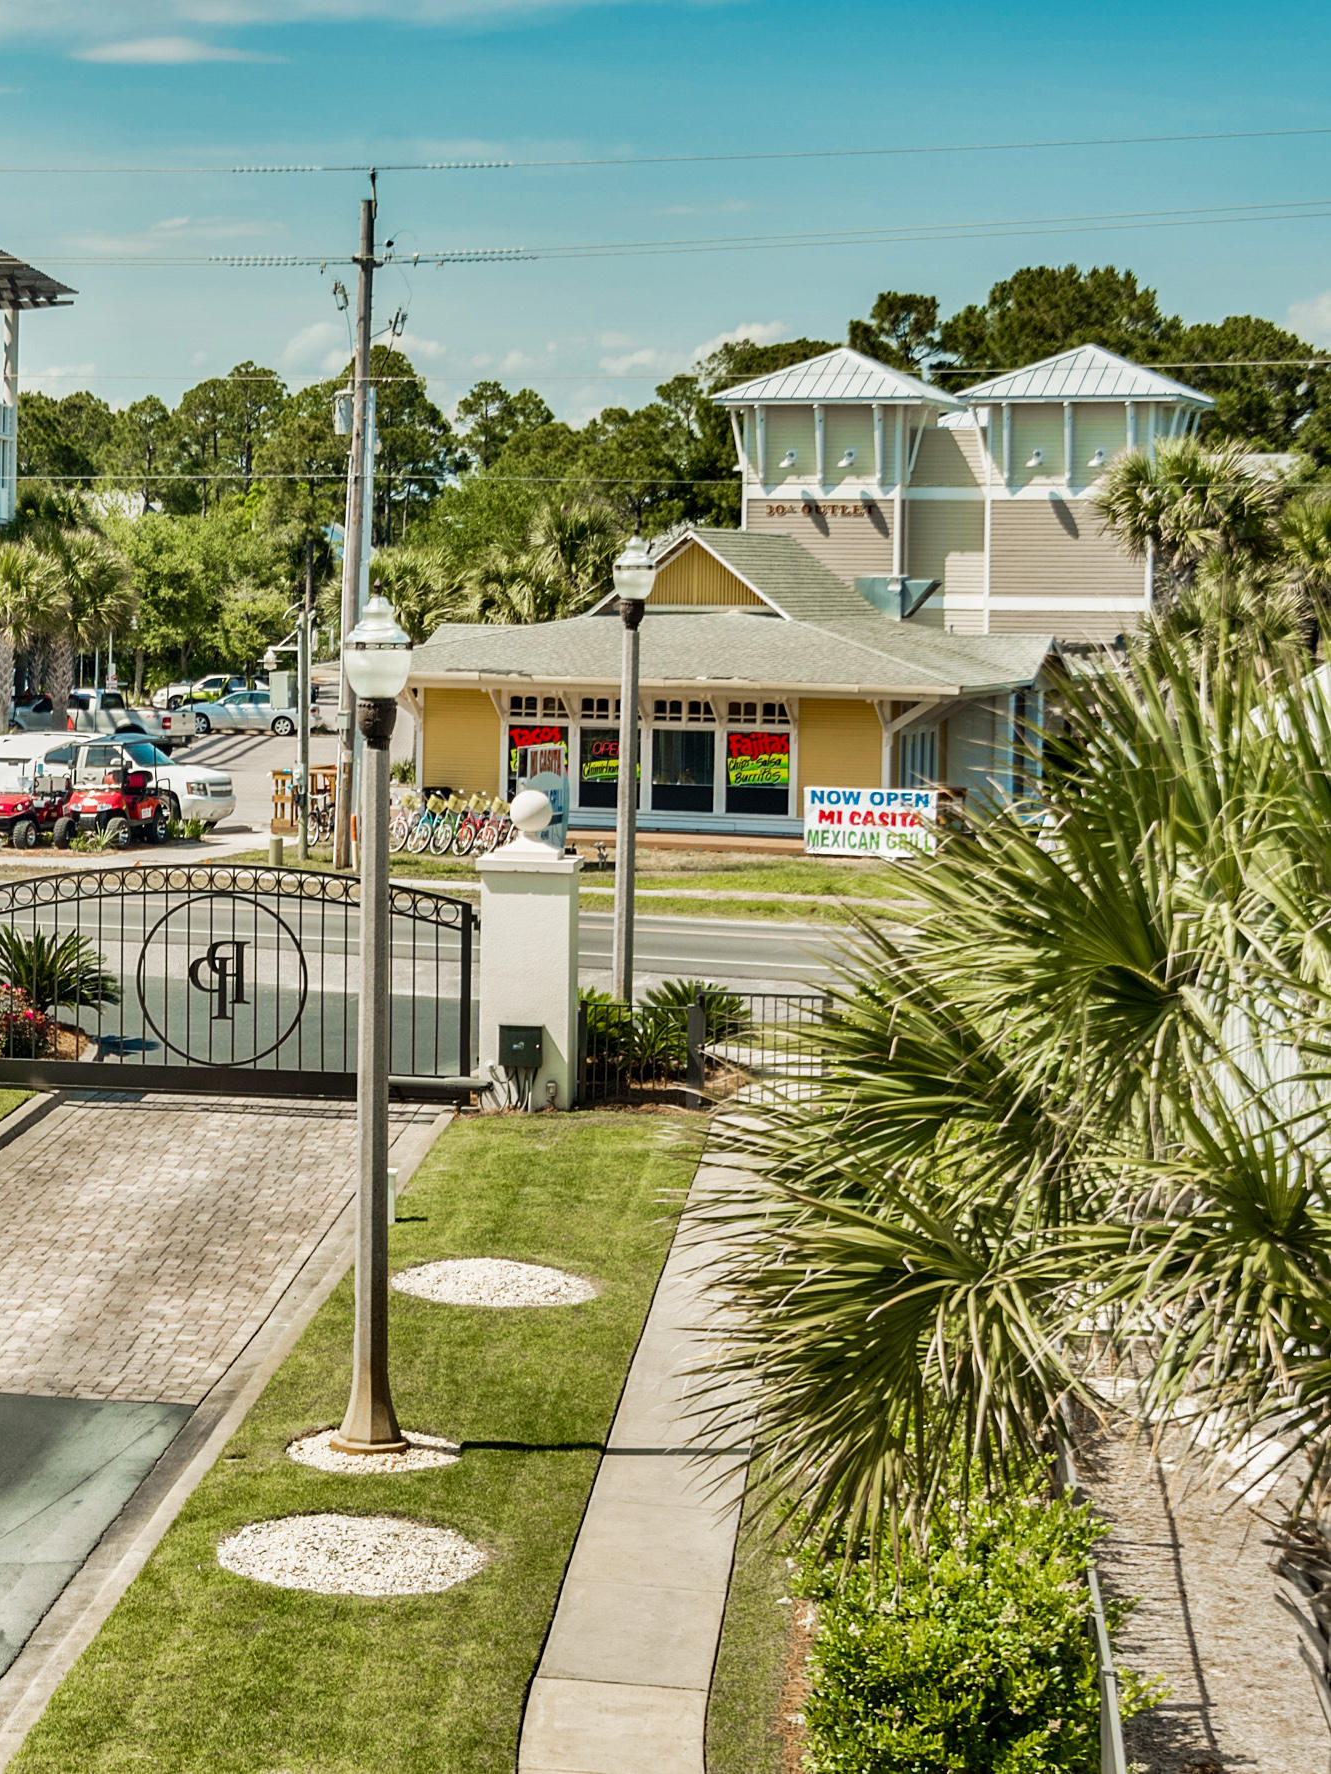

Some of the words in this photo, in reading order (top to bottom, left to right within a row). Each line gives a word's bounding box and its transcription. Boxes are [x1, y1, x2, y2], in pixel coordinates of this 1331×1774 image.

[801, 504, 875, 517] OUTLET
[592, 741, 619, 757] OPE
[727, 731, 790, 760] Fajitas
[734, 767, 781, 784] Burritos
[810, 790, 861, 806] NOW
[869, 792, 930, 808] OPEN
[818, 809, 842, 825] MI
[848, 811, 924, 828] CASITA
[807, 829, 880, 850] MEXICAN
